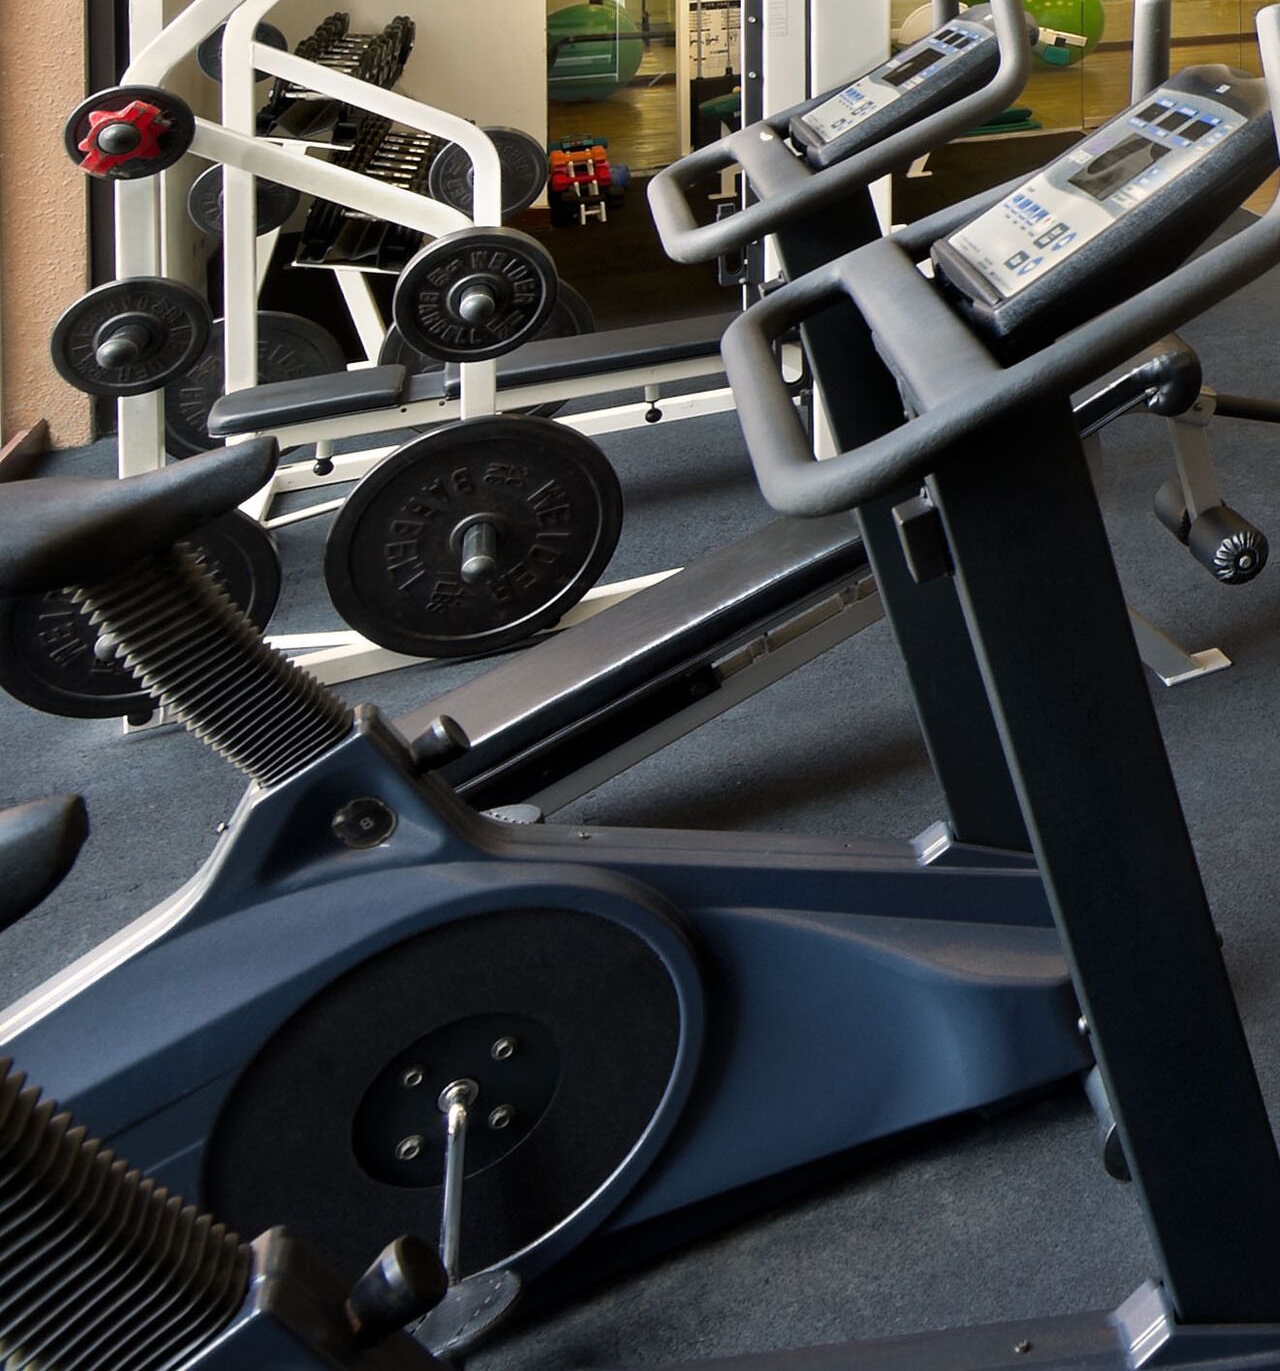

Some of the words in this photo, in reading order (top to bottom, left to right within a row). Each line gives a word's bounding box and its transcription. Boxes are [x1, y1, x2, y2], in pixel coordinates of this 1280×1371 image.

[418, 292, 483, 344] BARBELL
[470, 250, 536, 304] WEIDER
[385, 467, 475, 591] BARBELL
[488, 480, 570, 603] WEIDER
